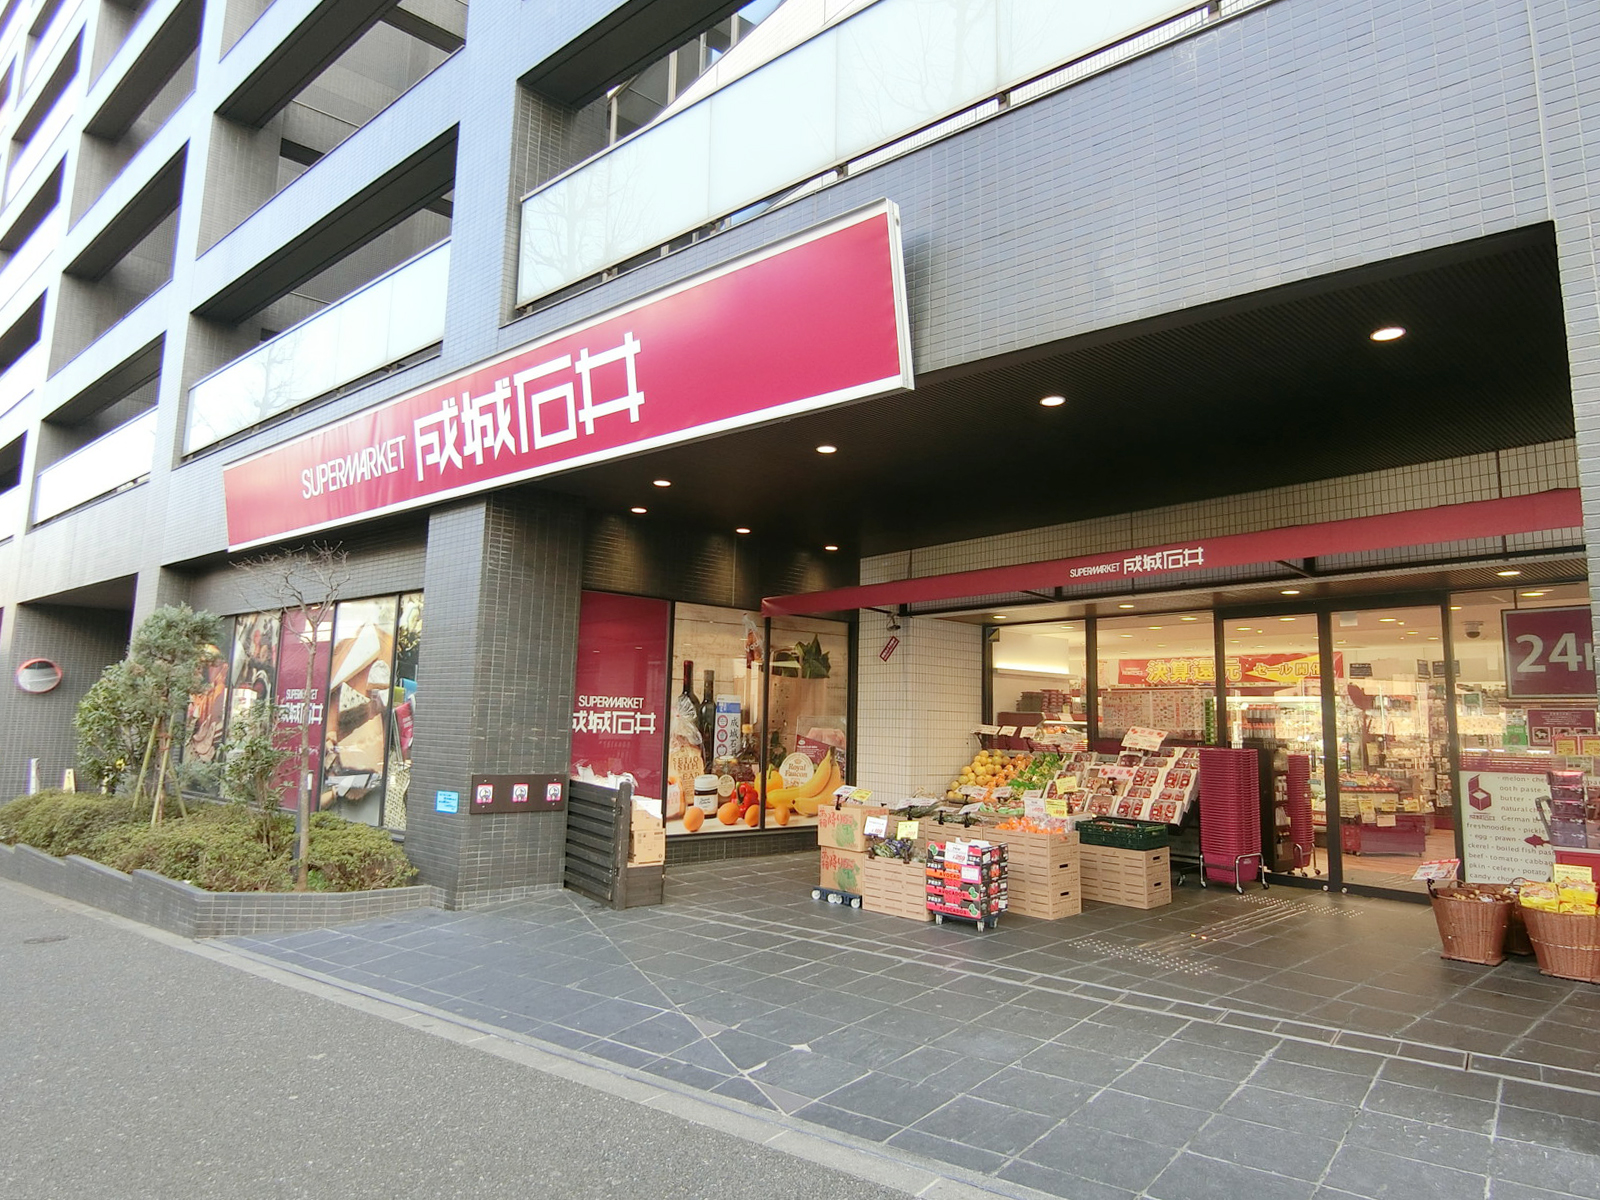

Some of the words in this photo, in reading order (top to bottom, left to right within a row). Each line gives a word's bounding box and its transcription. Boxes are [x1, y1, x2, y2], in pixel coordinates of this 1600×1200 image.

[301, 435, 406, 500] SUPERMARKET
[413, 331, 646, 482] 成城石井
[1069, 562, 1121, 578] SUPERMARKET
[1123, 546, 1204, 575] 成城石井
[1146, 658, 1242, 684] 決算還元
[578, 695, 644, 709] SUPERMARKET
[572, 710, 656, 735] 成城石井
[1501, 815, 1530, 823] German
[1522, 868, 1547, 876] potato
